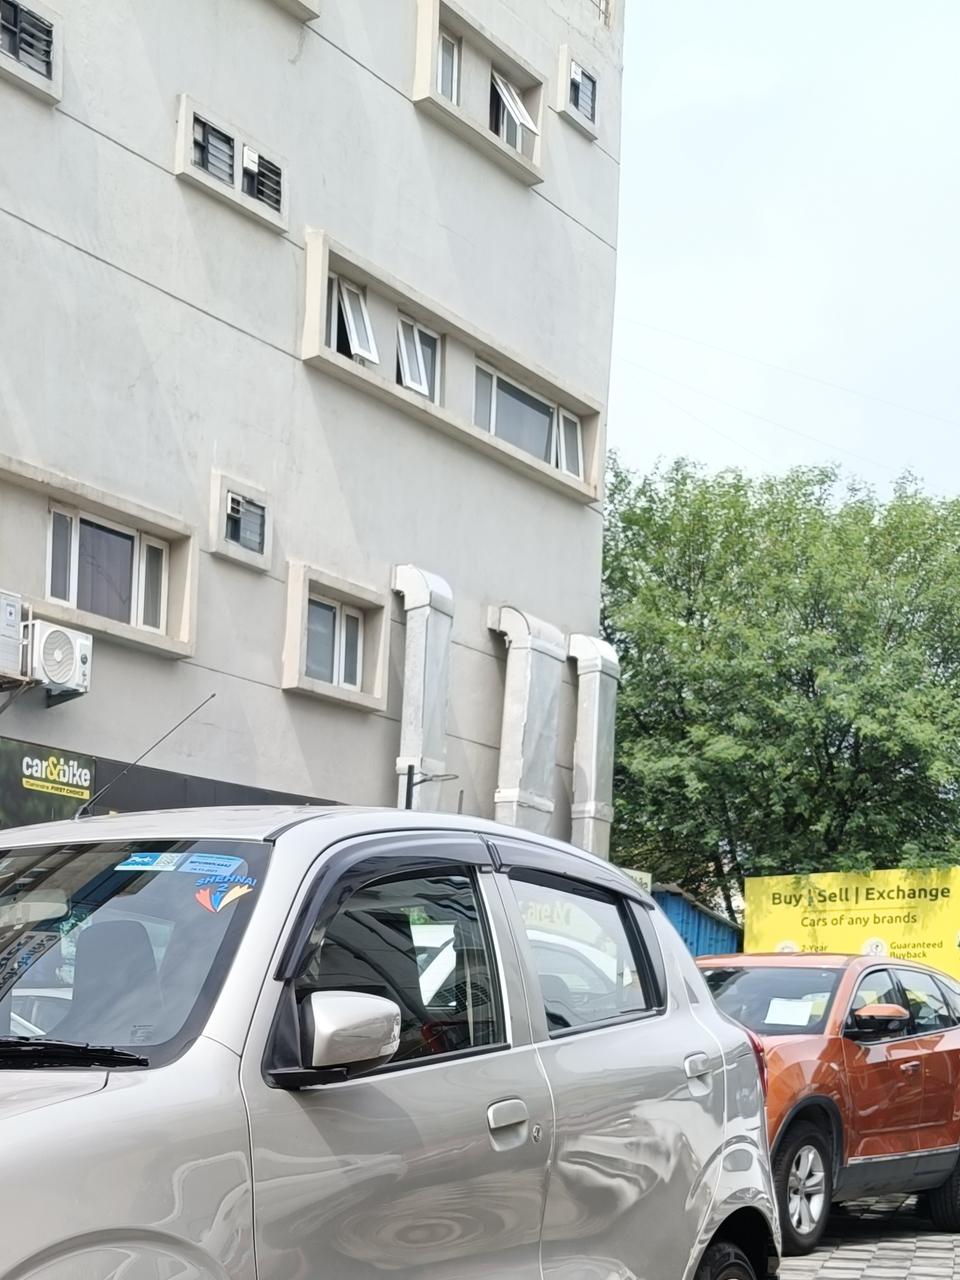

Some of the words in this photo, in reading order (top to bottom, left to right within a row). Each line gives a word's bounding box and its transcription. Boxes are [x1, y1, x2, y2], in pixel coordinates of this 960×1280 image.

[22, 756, 91, 787] car&bike
[195, 874, 257, 887] SHEHNAI
[772, 891, 803, 907] Buy
[817, 888, 850, 904] Sell
[865, 885, 951, 903] Exchange
[800, 916, 828, 927] Cars
[831, 914, 846, 926] of
[847, 916, 870, 927] any
[873, 912, 917, 925] brands
[890, 939, 943, 950] Guaranteed
